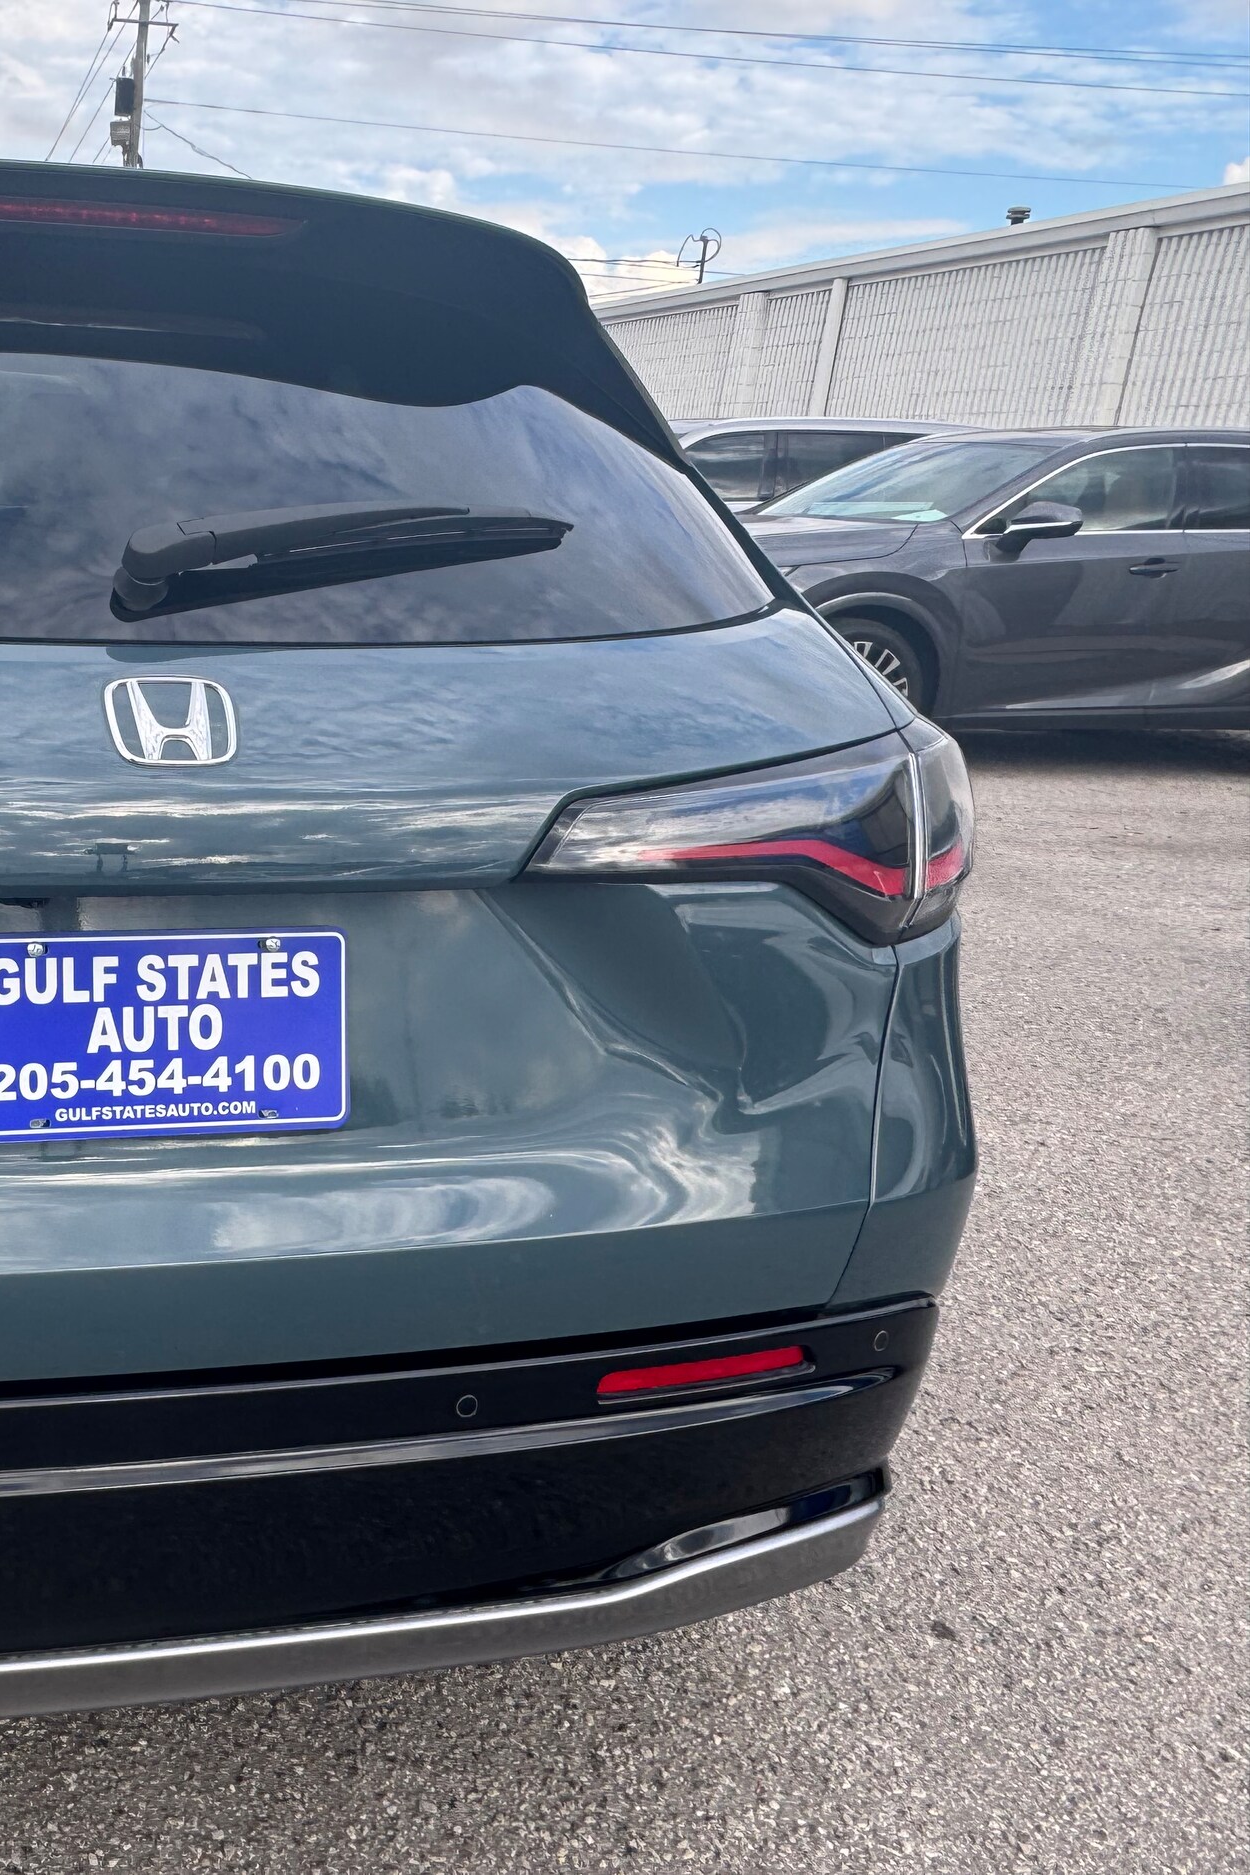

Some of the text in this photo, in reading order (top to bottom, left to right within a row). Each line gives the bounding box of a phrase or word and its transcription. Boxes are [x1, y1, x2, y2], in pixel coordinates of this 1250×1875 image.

[136, 950, 321, 1002] STATES
[86, 1004, 224, 1054] AUTO
[54, 1100, 257, 1122] GULFSTATESAUTO.COM
